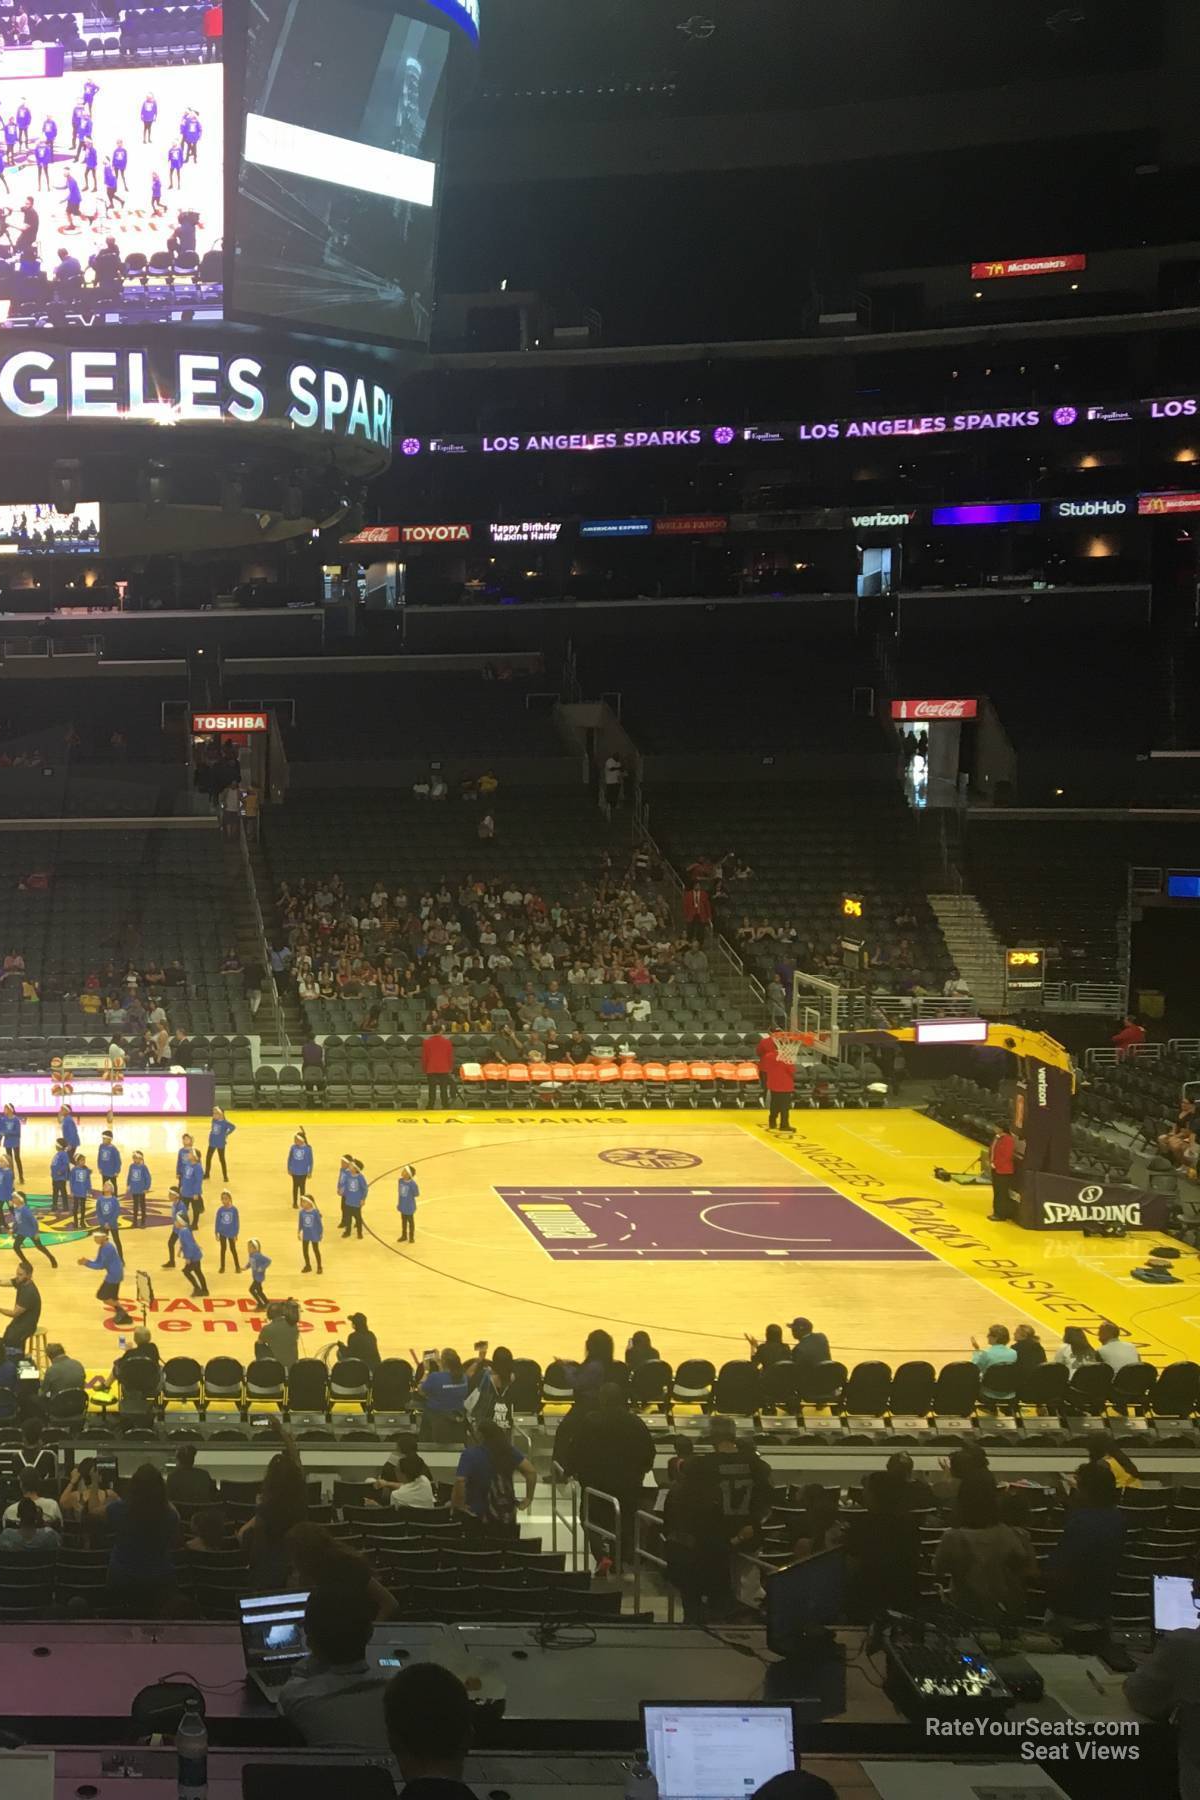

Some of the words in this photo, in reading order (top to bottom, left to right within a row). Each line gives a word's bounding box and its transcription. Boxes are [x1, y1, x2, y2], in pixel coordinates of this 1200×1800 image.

[1008, 260, 1066, 272] McDonald's
[1151, 400, 1197, 418] LOS
[800, 423, 839, 440] LOS
[845, 418, 946, 437] ANGELES
[953, 411, 1040, 430] SPARKS
[483, 437, 519, 452] LOS
[526, 433, 616, 451] ANGELES
[624, 430, 700, 446] SPARKS
[1059, 501, 1126, 517] StubHub
[852, 512, 909, 527] verizon
[403, 526, 469, 540] TOYOTA
[490, 524, 519, 535] Happy
[522, 522, 562, 532] Birthday
[494, 532, 528, 541] Maxine
[530, 531, 557, 541] Harris
[194, 717, 266, 729] TOSHIBA
[1037, 1067, 1048, 1106] verizon
[1043, 1202, 1143, 1226] SPALDING
